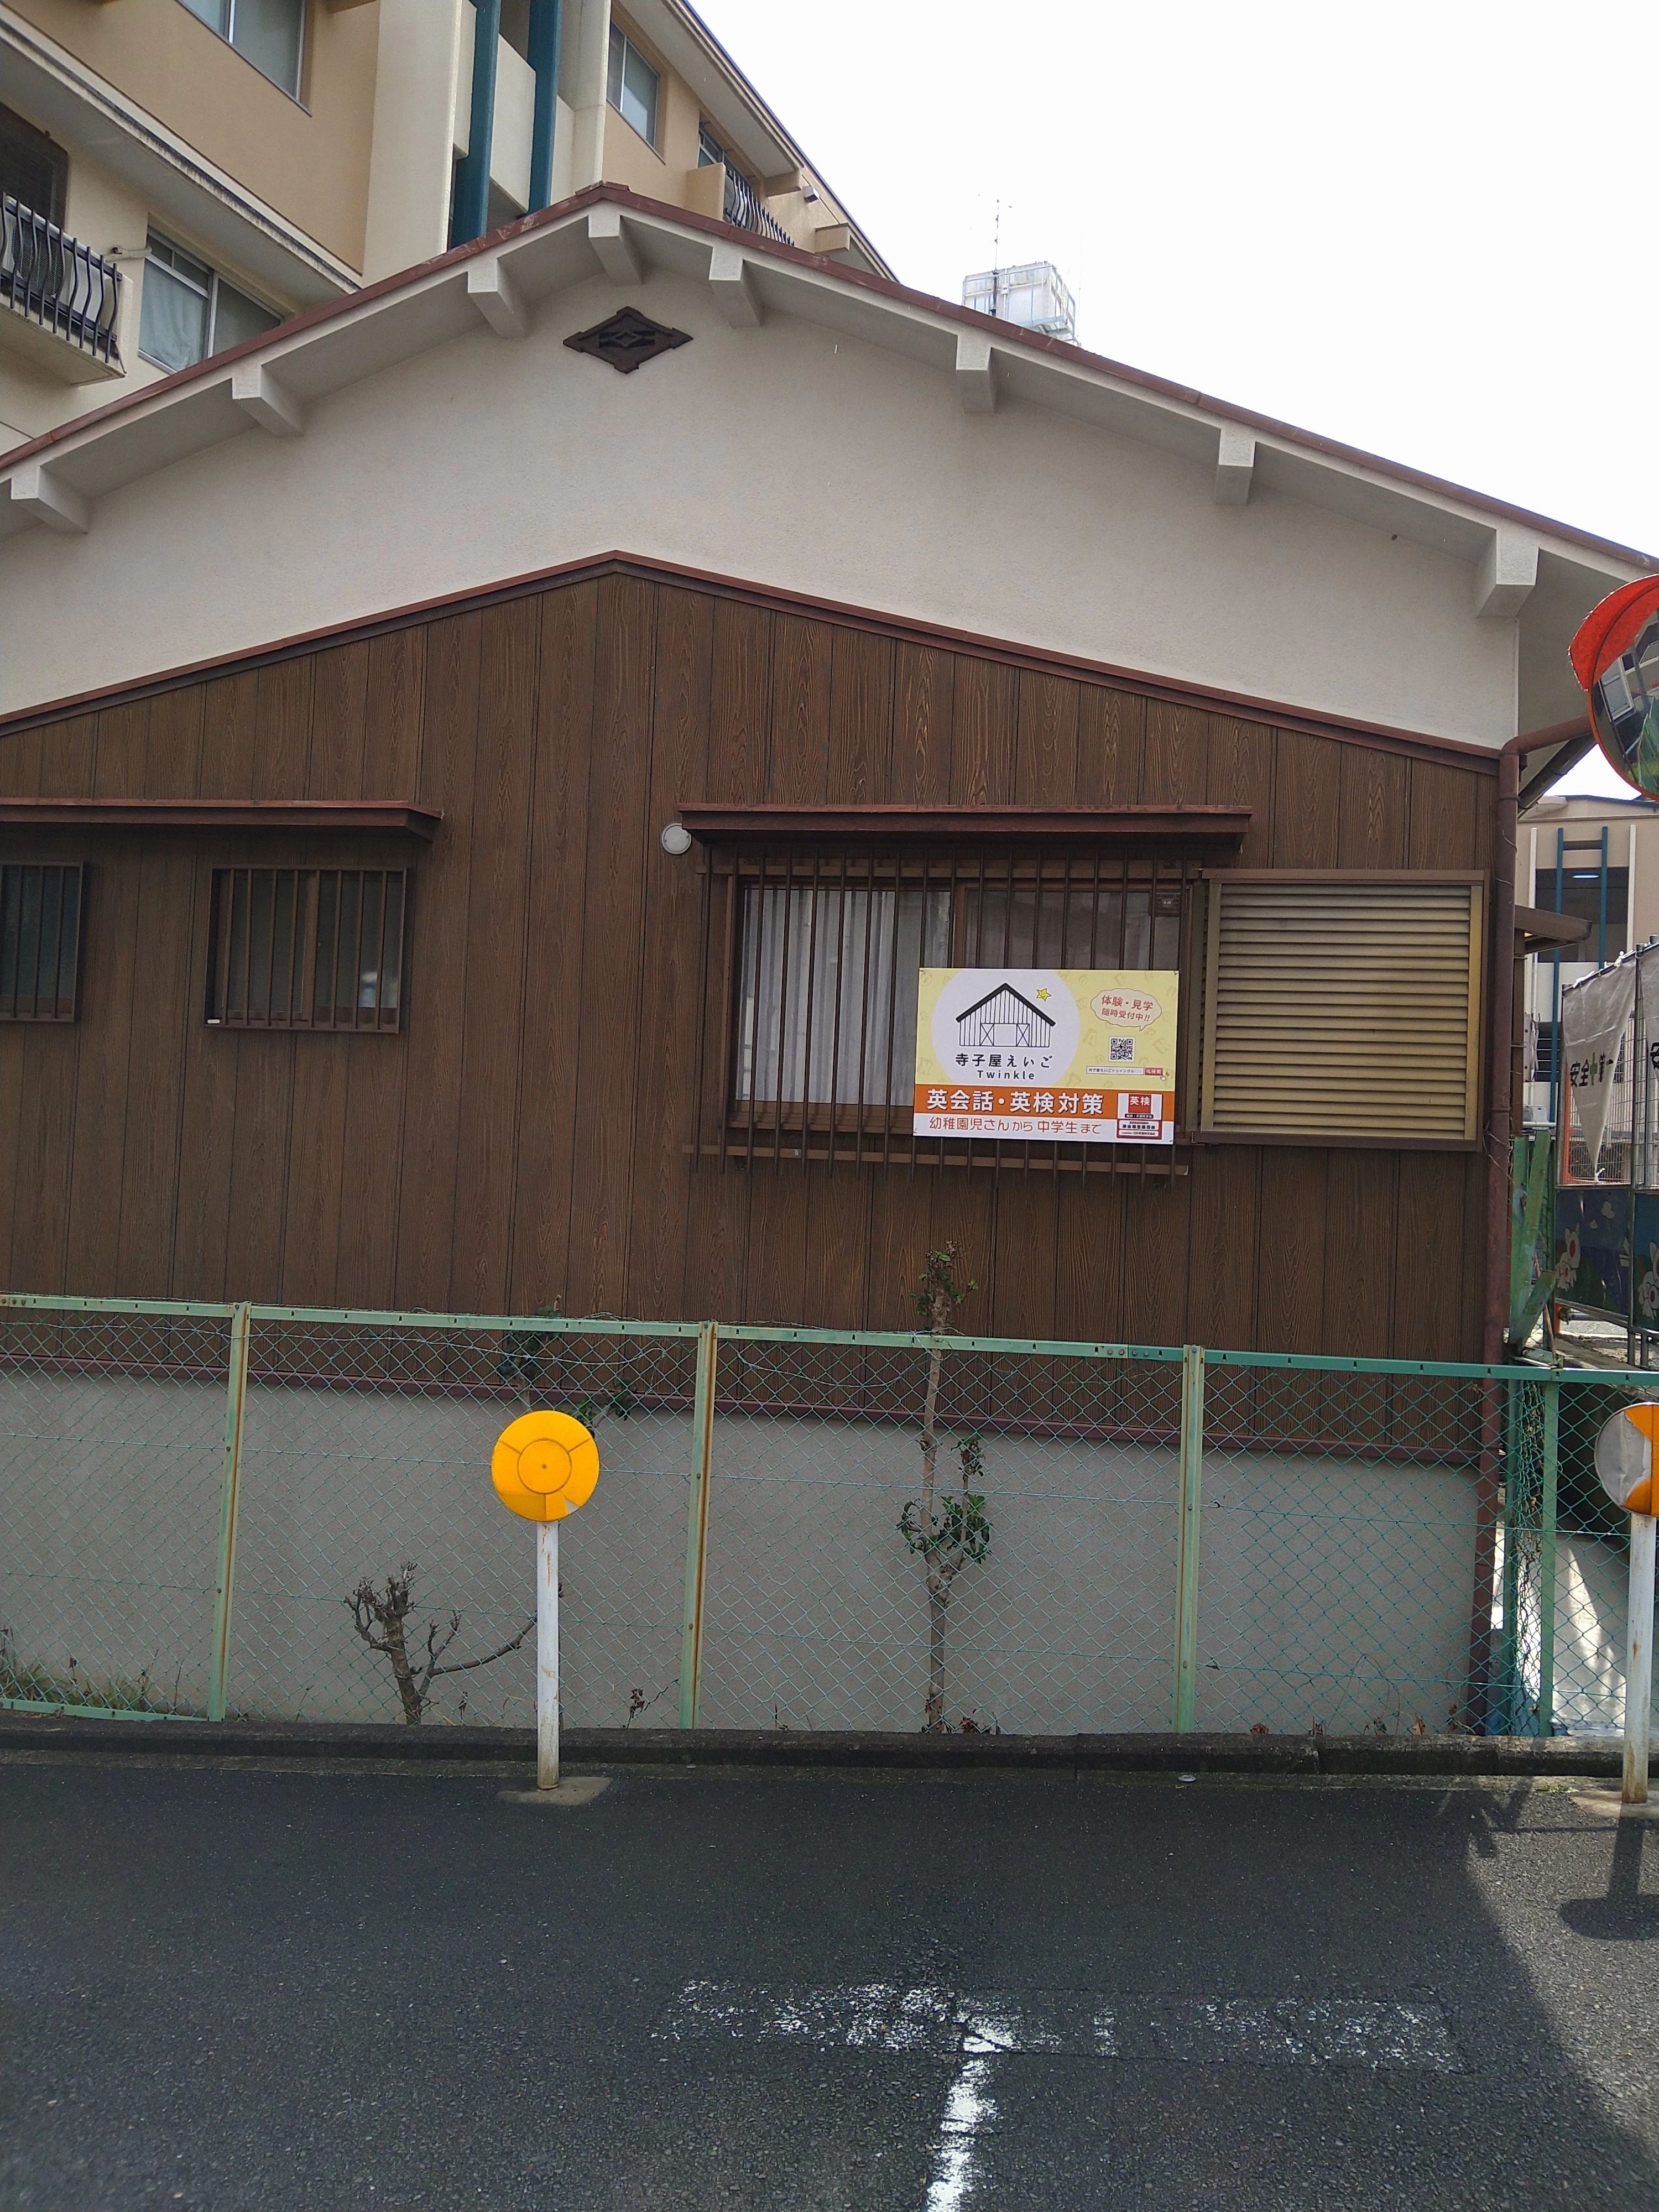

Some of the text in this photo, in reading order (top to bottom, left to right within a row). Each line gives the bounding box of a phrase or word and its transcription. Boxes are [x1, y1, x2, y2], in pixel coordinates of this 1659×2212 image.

[1102, 995, 1153, 1011] 体験・見学
[955, 1053, 1053, 1068] 寺子屋えいご
[977, 1070, 1035, 1080] Twinkle
[927, 1088, 1103, 1115] 英会話・英検対策
[1130, 1096, 1150, 1106] 英検
